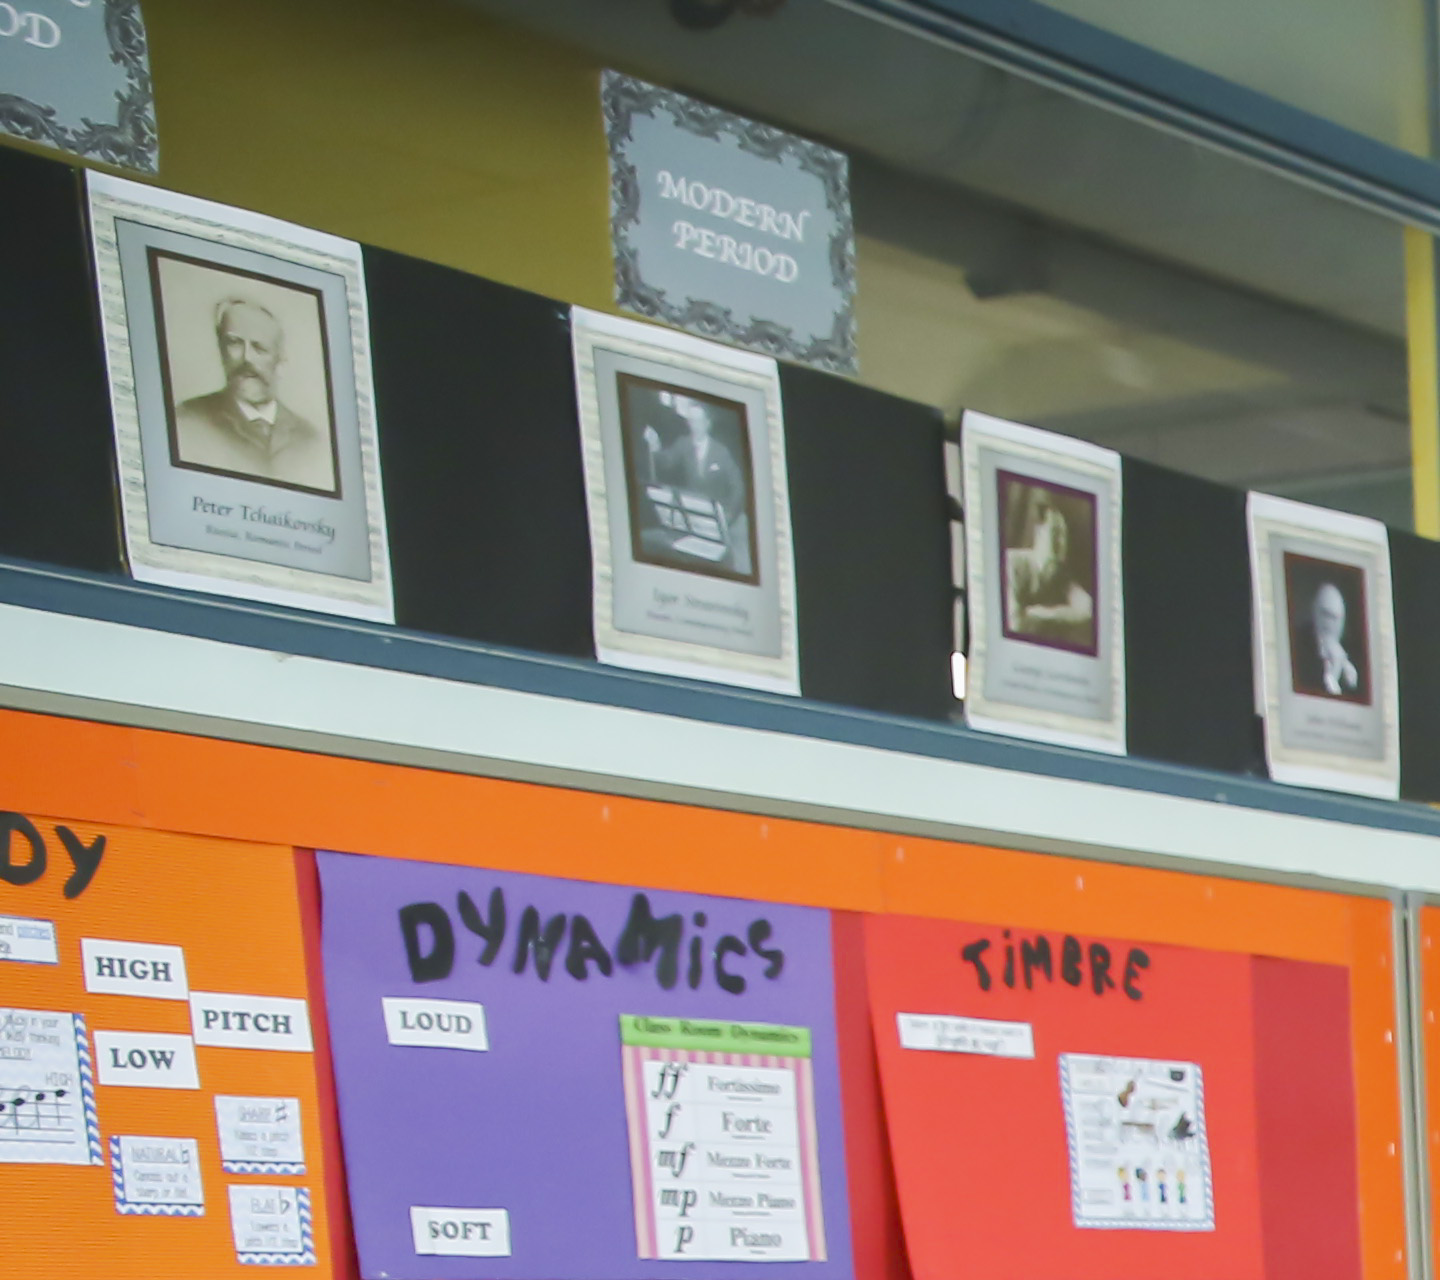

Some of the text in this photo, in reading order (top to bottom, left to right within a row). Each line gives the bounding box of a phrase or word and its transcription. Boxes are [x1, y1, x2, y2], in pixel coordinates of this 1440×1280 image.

[657, 170, 812, 243] MODERN
[672, 220, 797, 283] PERIOD
[192, 496, 335, 544] Peter Tchaikovsky
[94, 956, 172, 982] HIGH
[202, 1009, 293, 1034] PITCH
[400, 1010, 472, 1034] LOUD
[110, 1048, 175, 1070] LOW
[722, 1112, 772, 1133] Forte
[428, 1219, 492, 1240] SOFT
[730, 1227, 781, 1247] Piano
